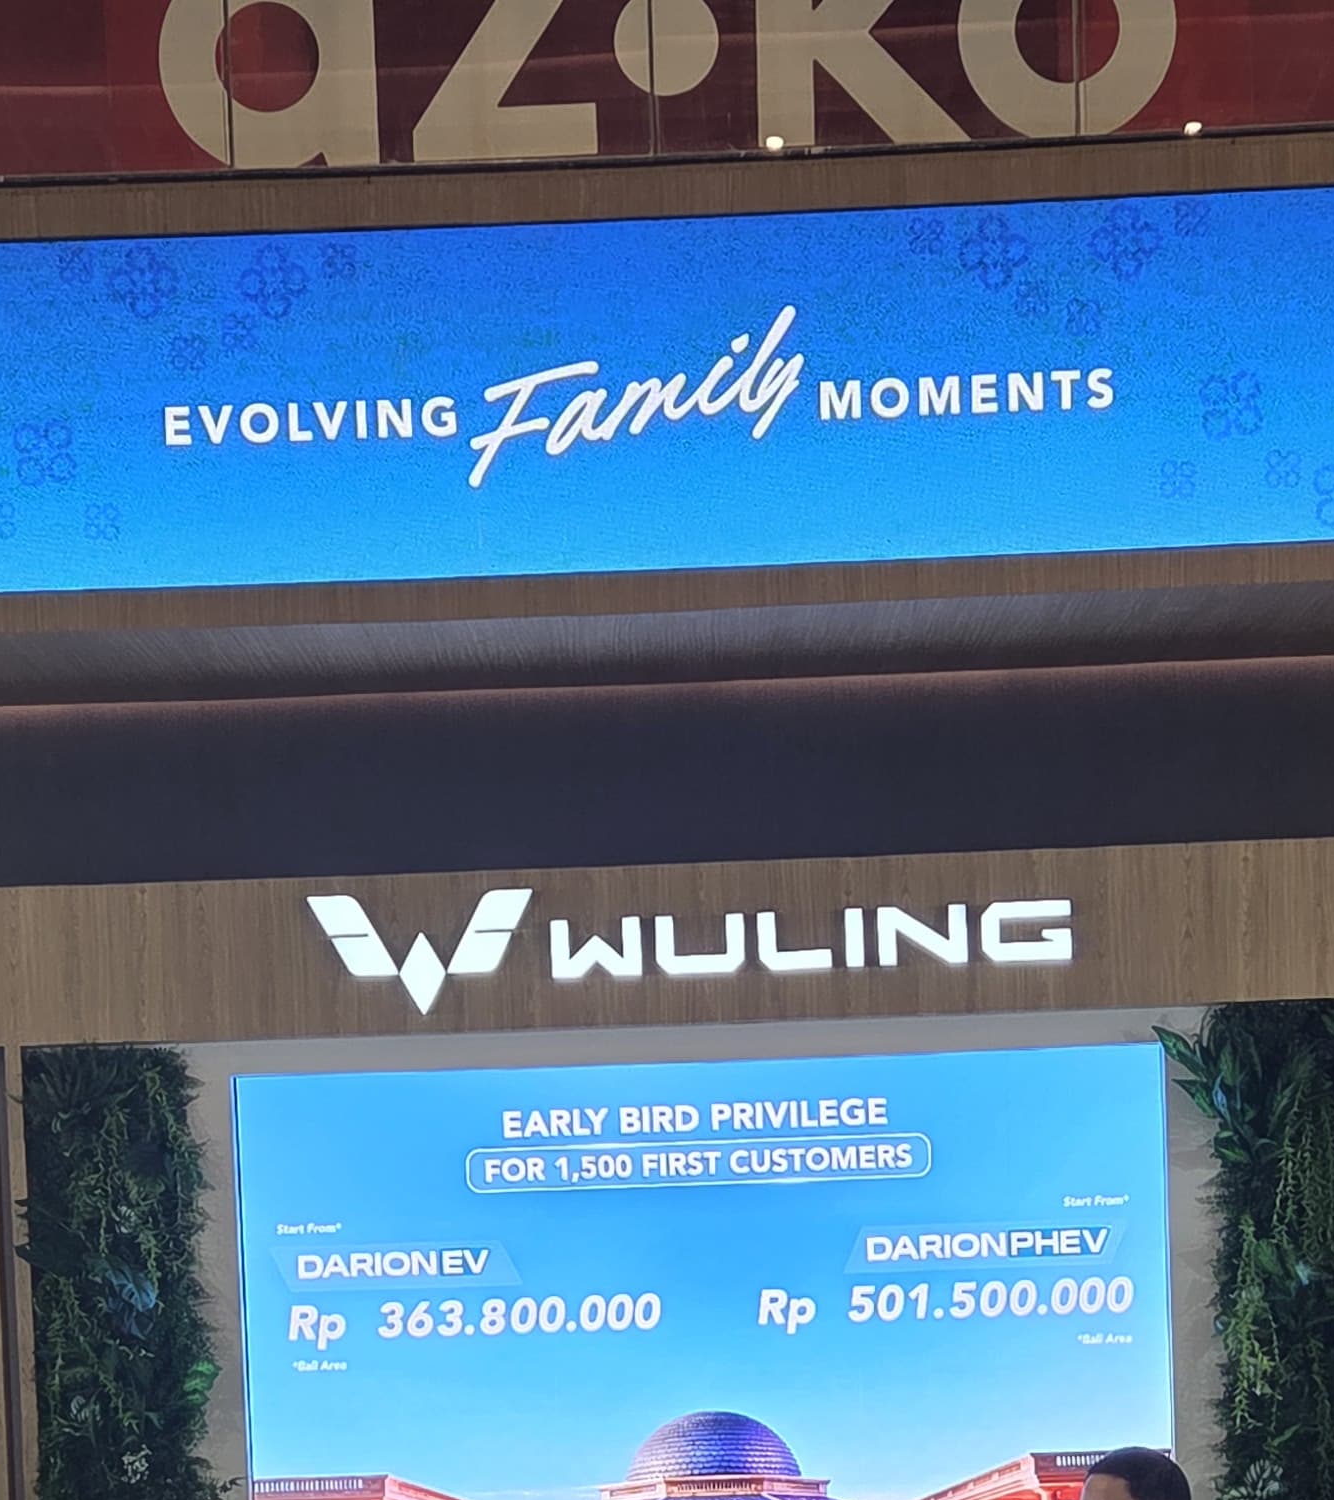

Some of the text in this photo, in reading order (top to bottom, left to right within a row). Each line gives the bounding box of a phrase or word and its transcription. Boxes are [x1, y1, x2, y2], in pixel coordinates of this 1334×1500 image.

[164, 304, 1116, 488] EVOLVING Family MOMENTS
[550, 899, 1073, 980] WULING
[502, 1097, 889, 1139] EARLY BIRD PRIVILEGE
[484, 1143, 913, 1184] FOR 1,500 FIRST CUSTOMERS
[1063, 1195, 1092, 1208] Start
[276, 1223, 305, 1235] Start
[288, 1292, 662, 1351] Rp 363.800.000
[757, 1275, 1134, 1334] Rp 501.500.000
[1105, 1333, 1132, 1345] Area
[320, 1360, 347, 1372] Area
